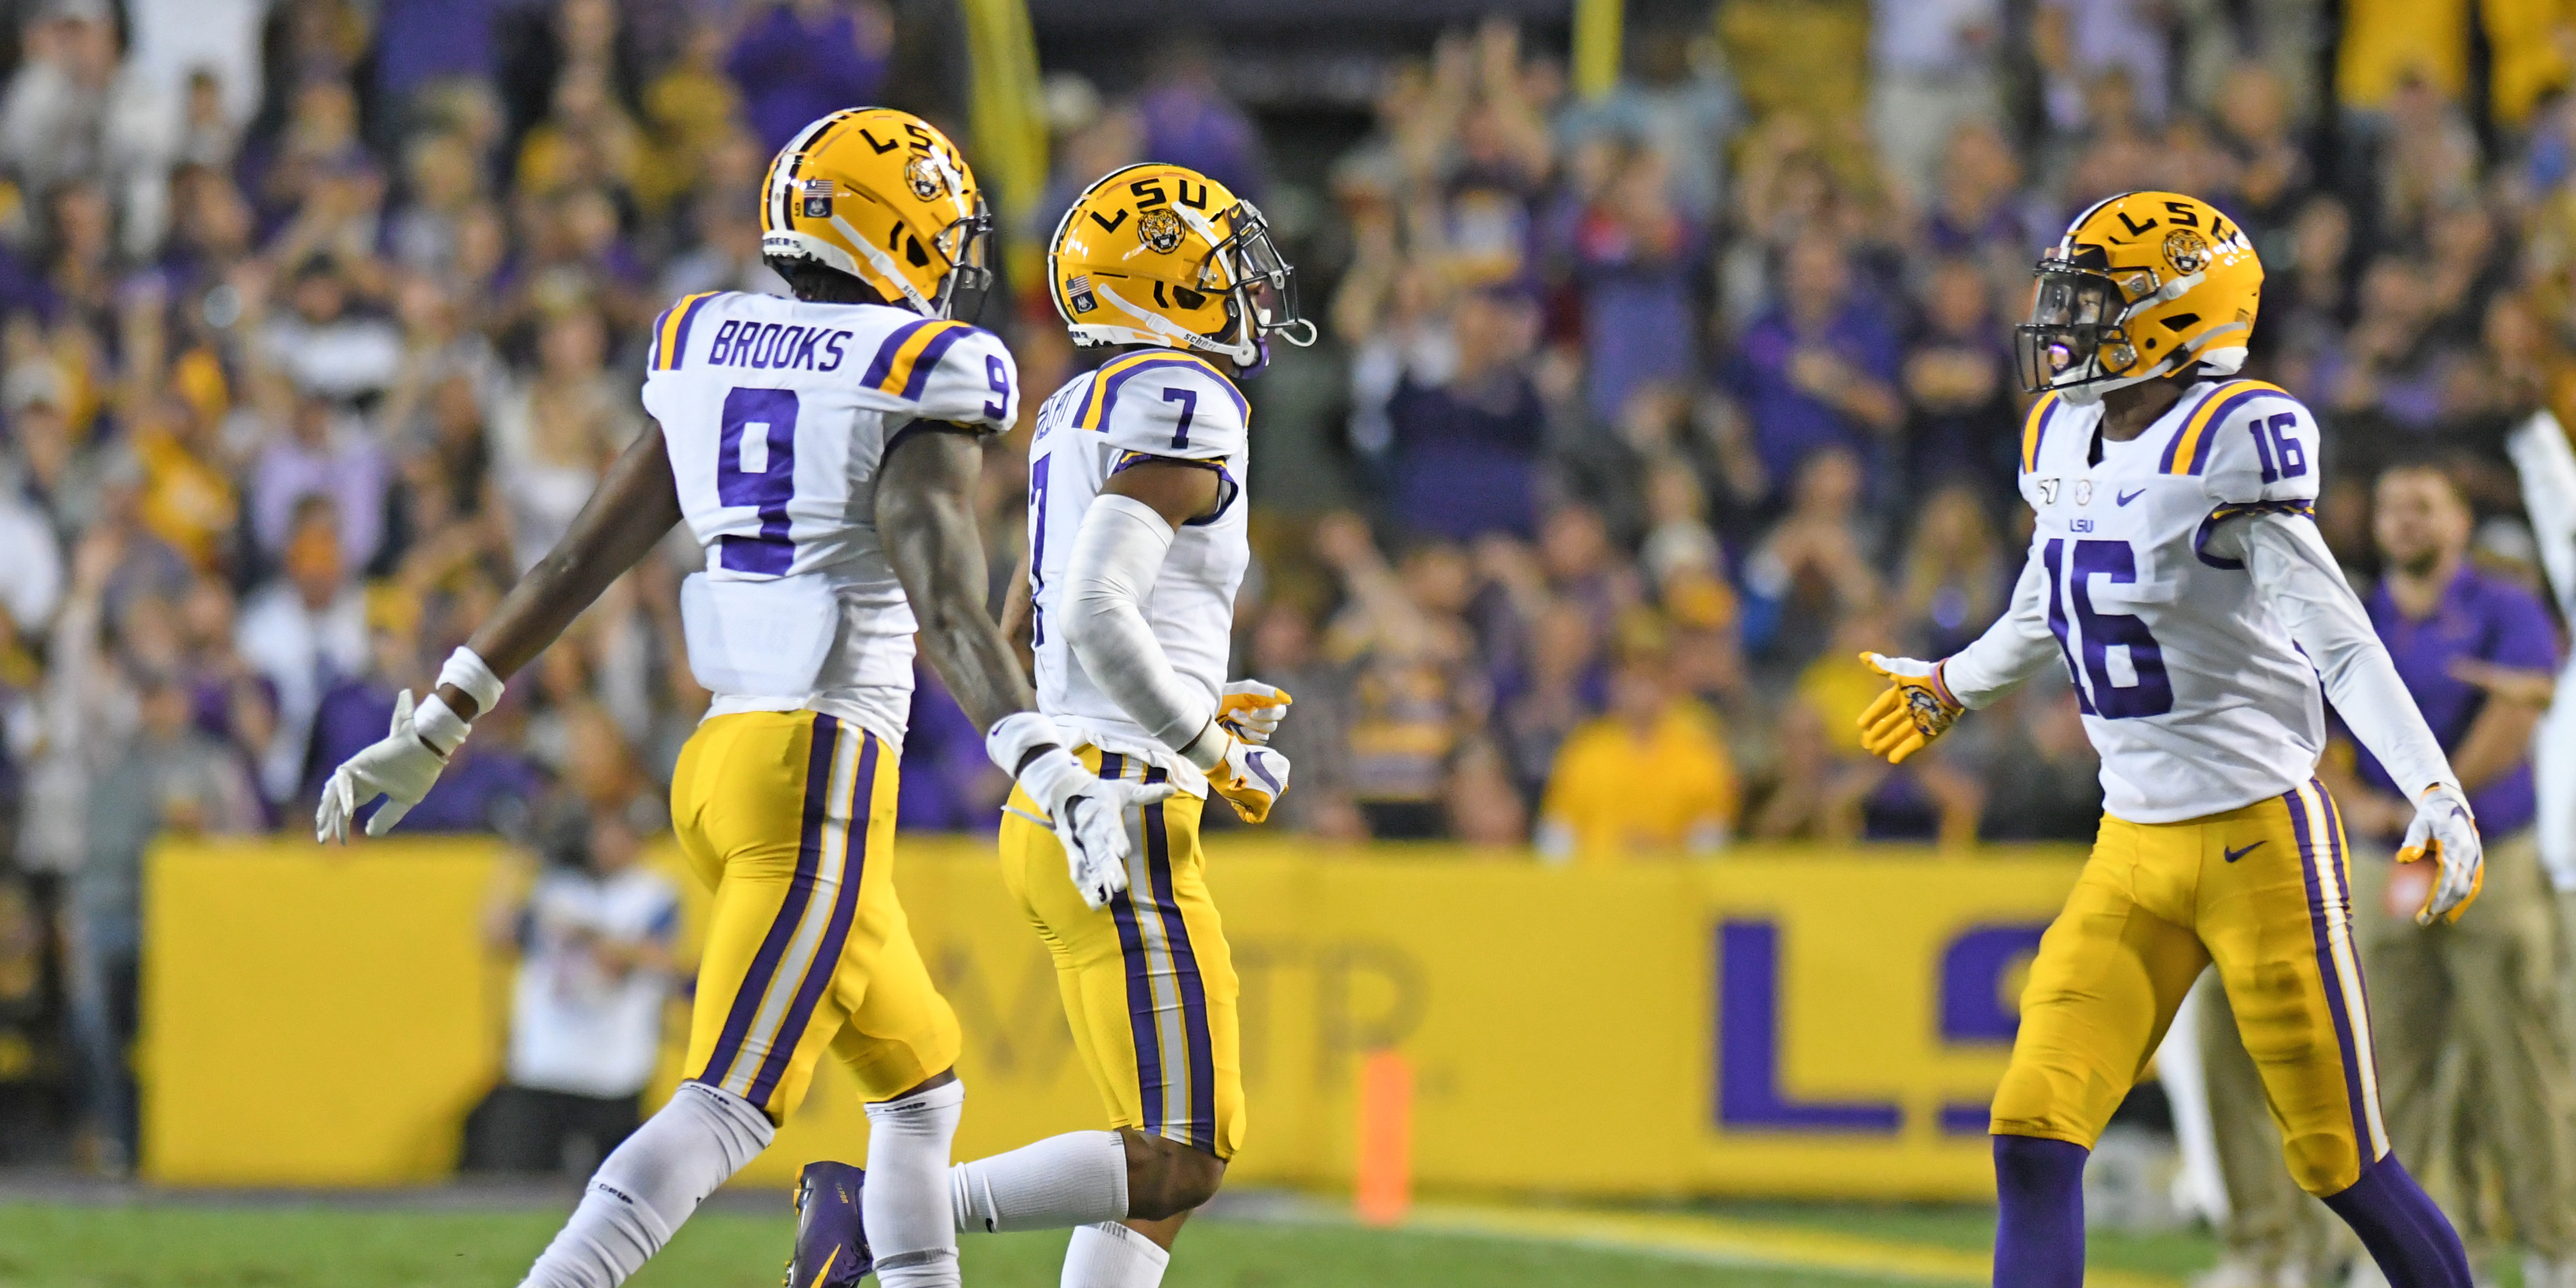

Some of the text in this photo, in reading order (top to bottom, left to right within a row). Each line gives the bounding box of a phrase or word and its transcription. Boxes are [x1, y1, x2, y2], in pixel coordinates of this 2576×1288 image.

[1090, 178, 1206, 233] LSU
[708, 320, 854, 372] BROOKS
[984, 354, 1011, 420] 9
[1163, 387, 1197, 449] 7
[718, 386, 800, 576] 9
[2249, 412, 2307, 484] 16
[1030, 451, 1051, 647] 7
[2070, 518, 2094, 532] LSU
[2044, 538, 2174, 720] 16
